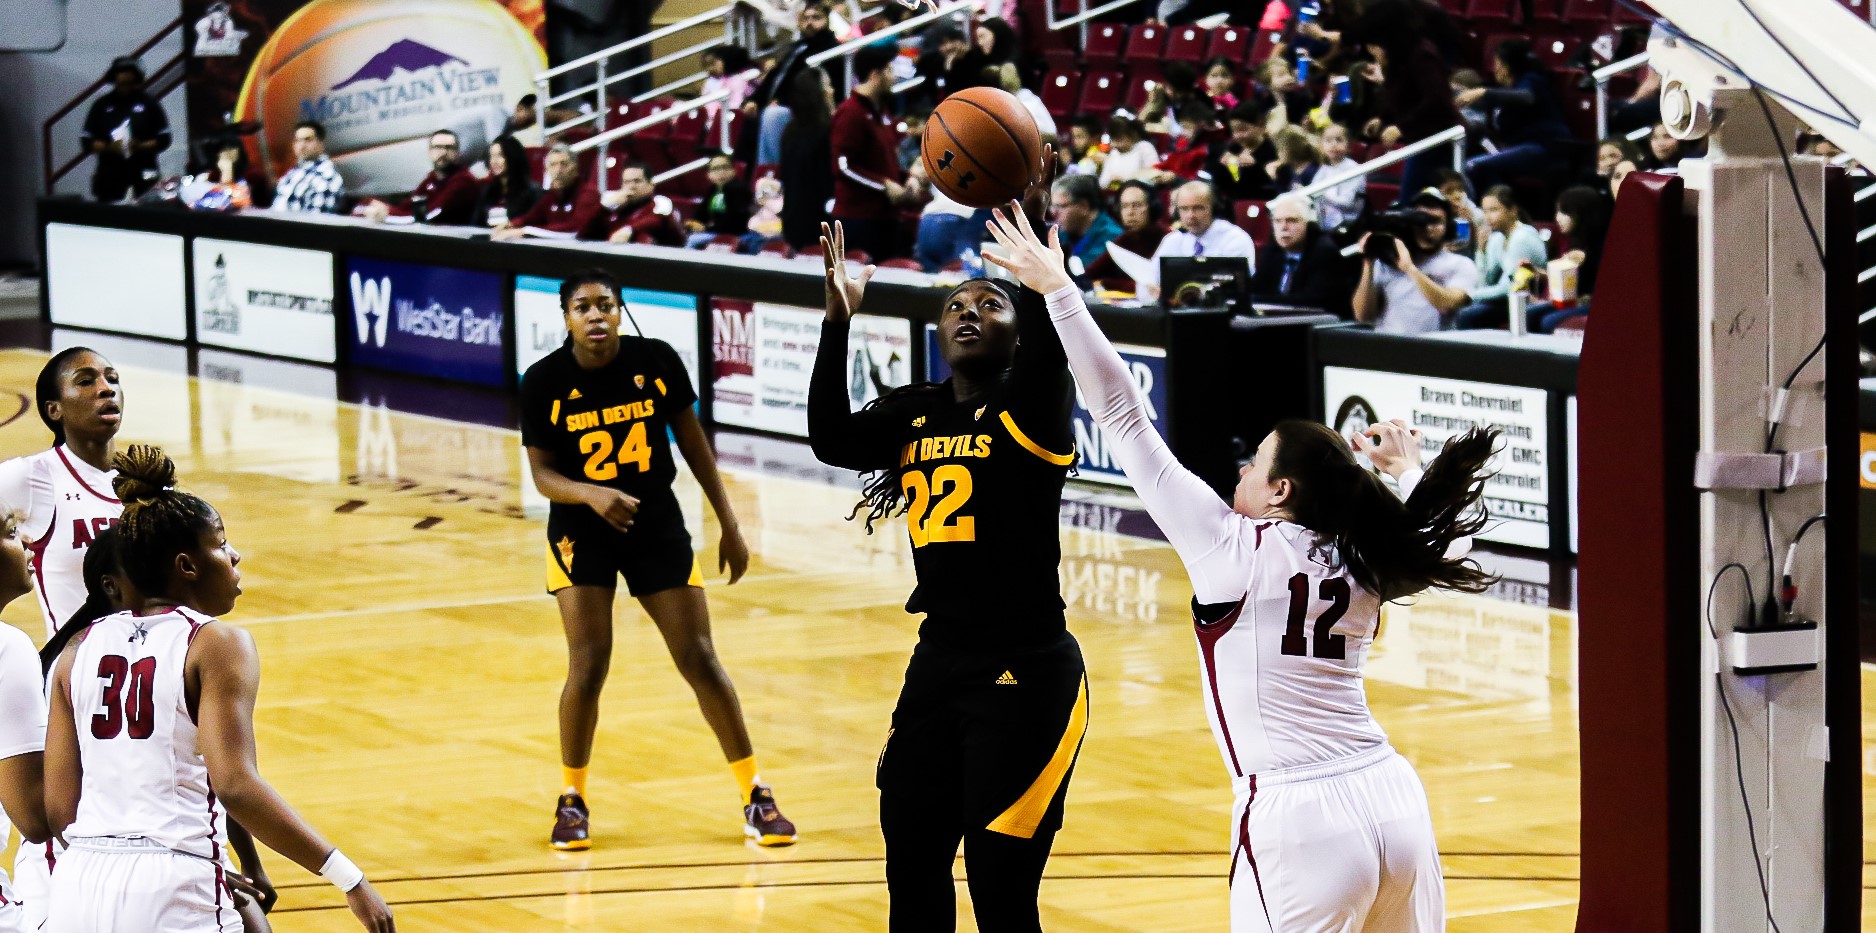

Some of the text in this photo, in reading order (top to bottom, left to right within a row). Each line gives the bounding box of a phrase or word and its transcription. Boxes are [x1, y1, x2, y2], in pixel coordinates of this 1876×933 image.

[462, 306, 502, 346] Bank
[566, 400, 655, 432] SUN DEVILS
[1461, 391, 1522, 414] Chevrolet
[579, 422, 652, 481] 24
[921, 435, 992, 461] DEVILS
[1512, 447, 1541, 464] GMC
[901, 464, 975, 548] 22
[1281, 572, 1351, 660] 12
[91, 655, 156, 740] 30
